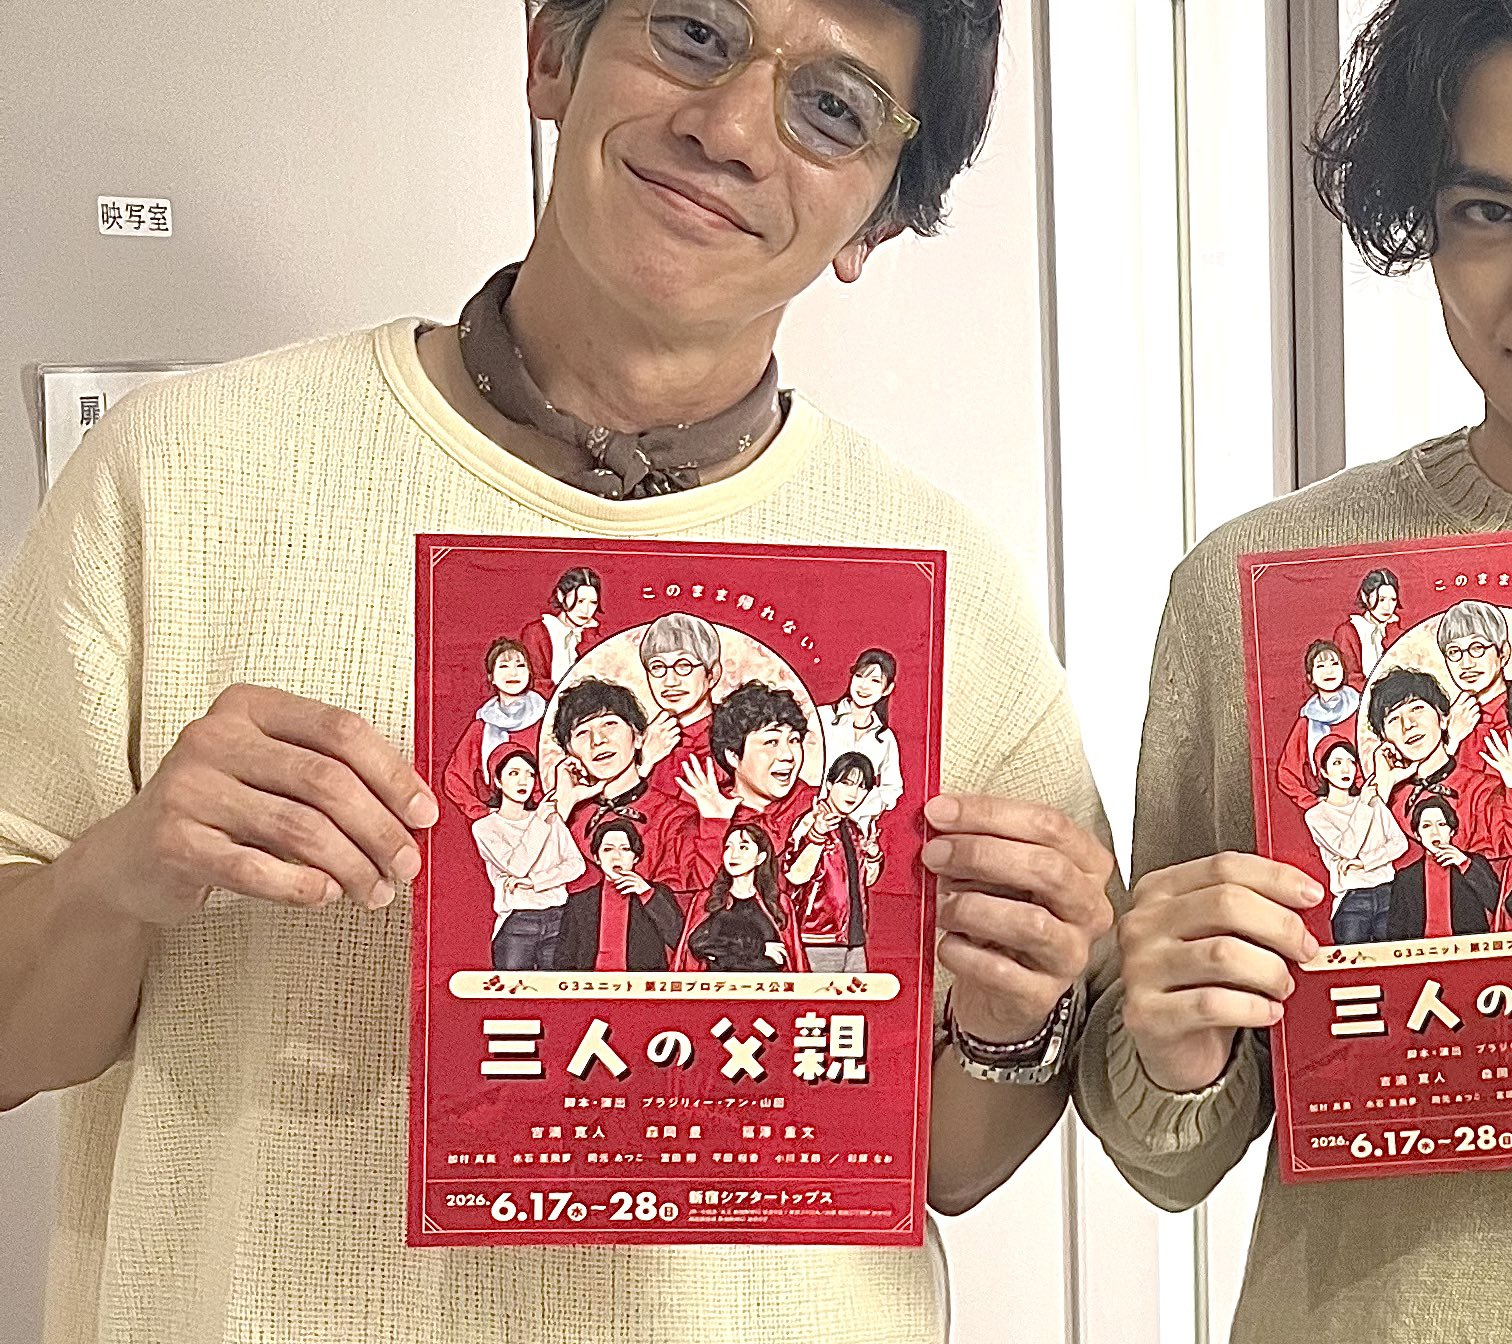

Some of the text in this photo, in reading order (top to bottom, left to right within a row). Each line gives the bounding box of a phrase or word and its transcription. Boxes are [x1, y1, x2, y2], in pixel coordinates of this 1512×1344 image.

[100, 201, 169, 232] 映写室
[480, 1011, 867, 1081] 三人の父親
